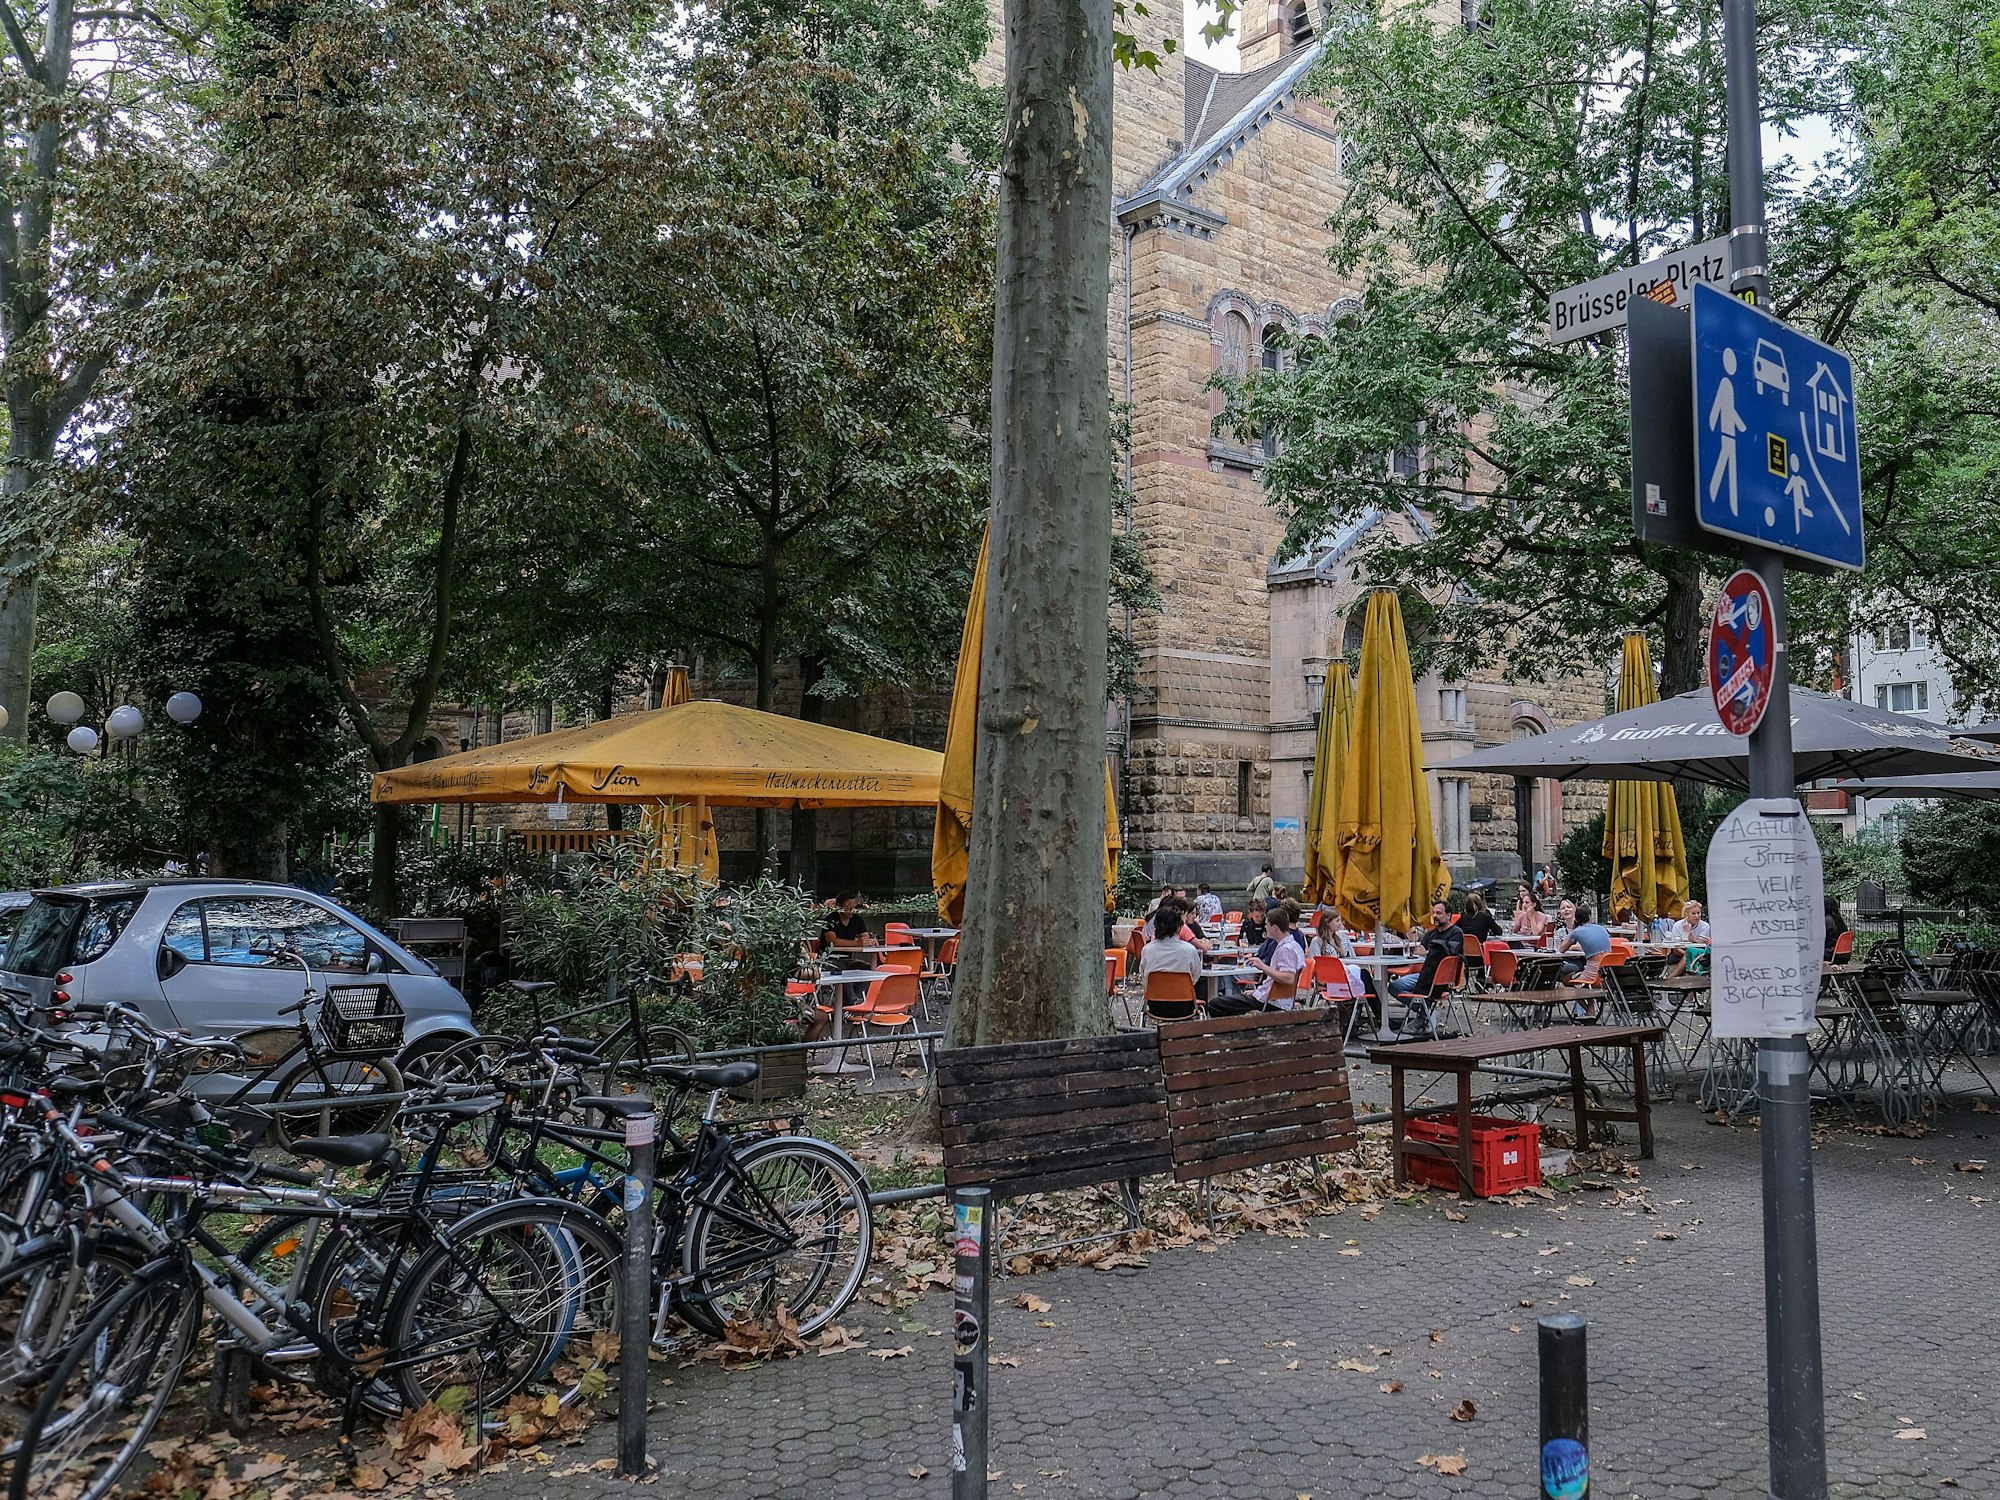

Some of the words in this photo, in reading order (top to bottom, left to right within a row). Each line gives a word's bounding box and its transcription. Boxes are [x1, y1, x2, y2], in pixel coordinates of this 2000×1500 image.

[1556, 277, 1659, 330] Brüsseler
[1667, 255, 1724, 290] Platz
[1610, 722, 1698, 741] Gaffel
[590, 764, 640, 791] Sion
[1721, 955, 1771, 984] PLEASE
[1775, 966, 1797, 980] DO
[1722, 984, 1804, 1010] BICYCLES
